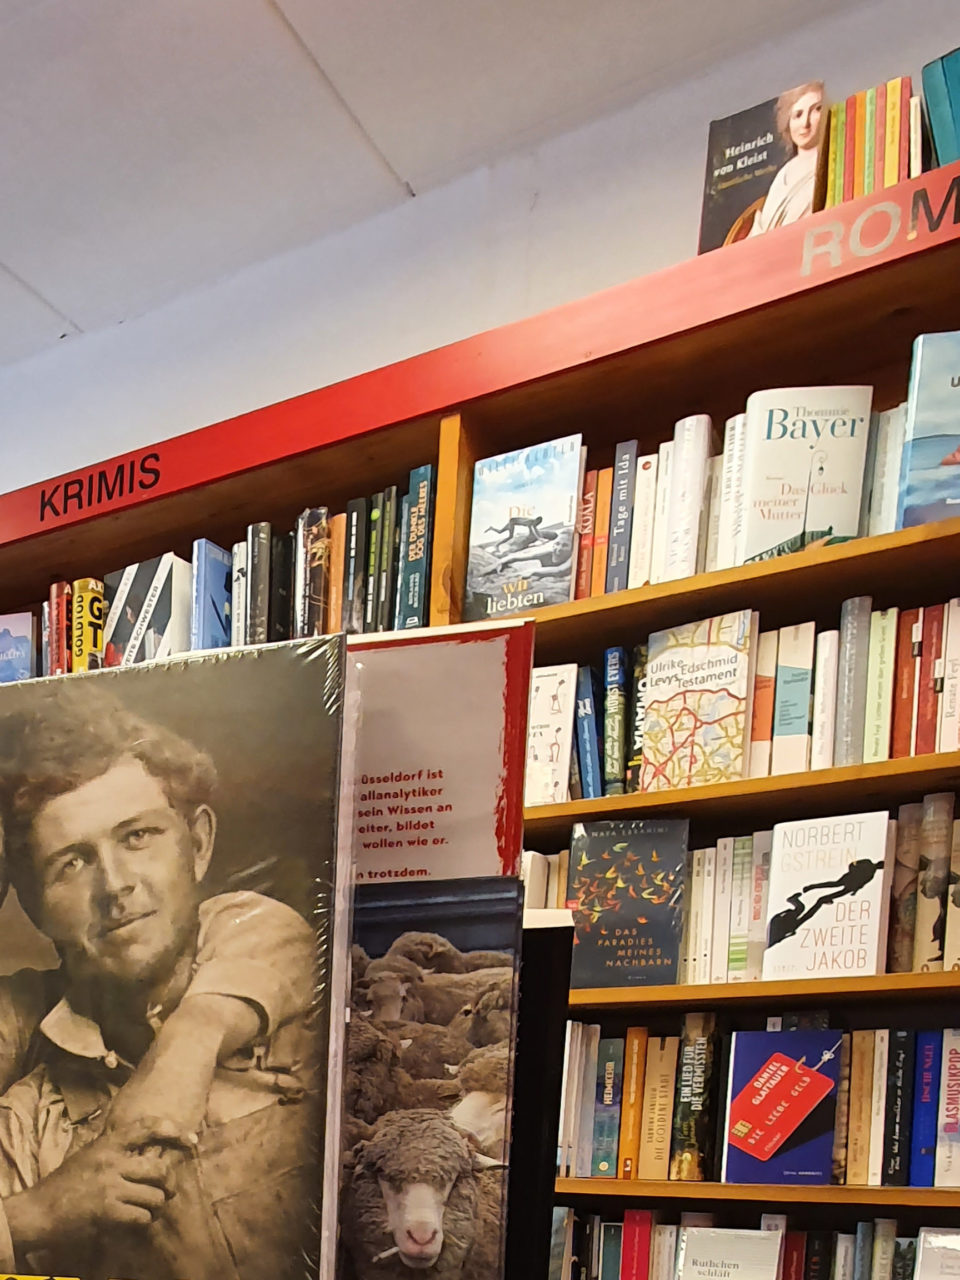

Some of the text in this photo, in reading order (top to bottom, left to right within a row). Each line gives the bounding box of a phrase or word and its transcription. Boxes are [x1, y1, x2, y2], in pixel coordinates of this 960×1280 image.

[725, 133, 774, 159] Heinrich
[713, 163, 734, 177] von
[737, 150, 768, 170] Kleist
[763, 407, 865, 451] Bayer
[39, 452, 162, 522] KRIMIS
[613, 453, 630, 536] Tage mit Ida
[135, 585, 159, 641] SCHWESTER
[486, 591, 545, 614] liebten
[74, 594, 84, 658] GOLDTOD
[649, 667, 738, 688] Levys Testament
[650, 654, 738, 676] Ulrike Edschmid
[427, 768, 444, 780] ist
[358, 802, 453, 818] sein Wissen an
[396, 819, 435, 832] bildet
[781, 820, 866, 849] NORBERT
[362, 835, 449, 850] wollen wie er.
[367, 866, 431, 879] trotzdem.
[780, 847, 858, 873] GSTREIN
[835, 900, 872, 924] DER
[800, 924, 869, 949] ZWEITE
[604, 957, 672, 969] NACHBARN
[806, 948, 868, 971] JAKOB
[680, 1065, 694, 1103] EIN LIED
[690, 1036, 708, 1111] DIE VERMISSTEN
[751, 1065, 790, 1106] GLATTAUER
[753, 1061, 781, 1089] DANIEL
[791, 1076, 811, 1098] GELD
